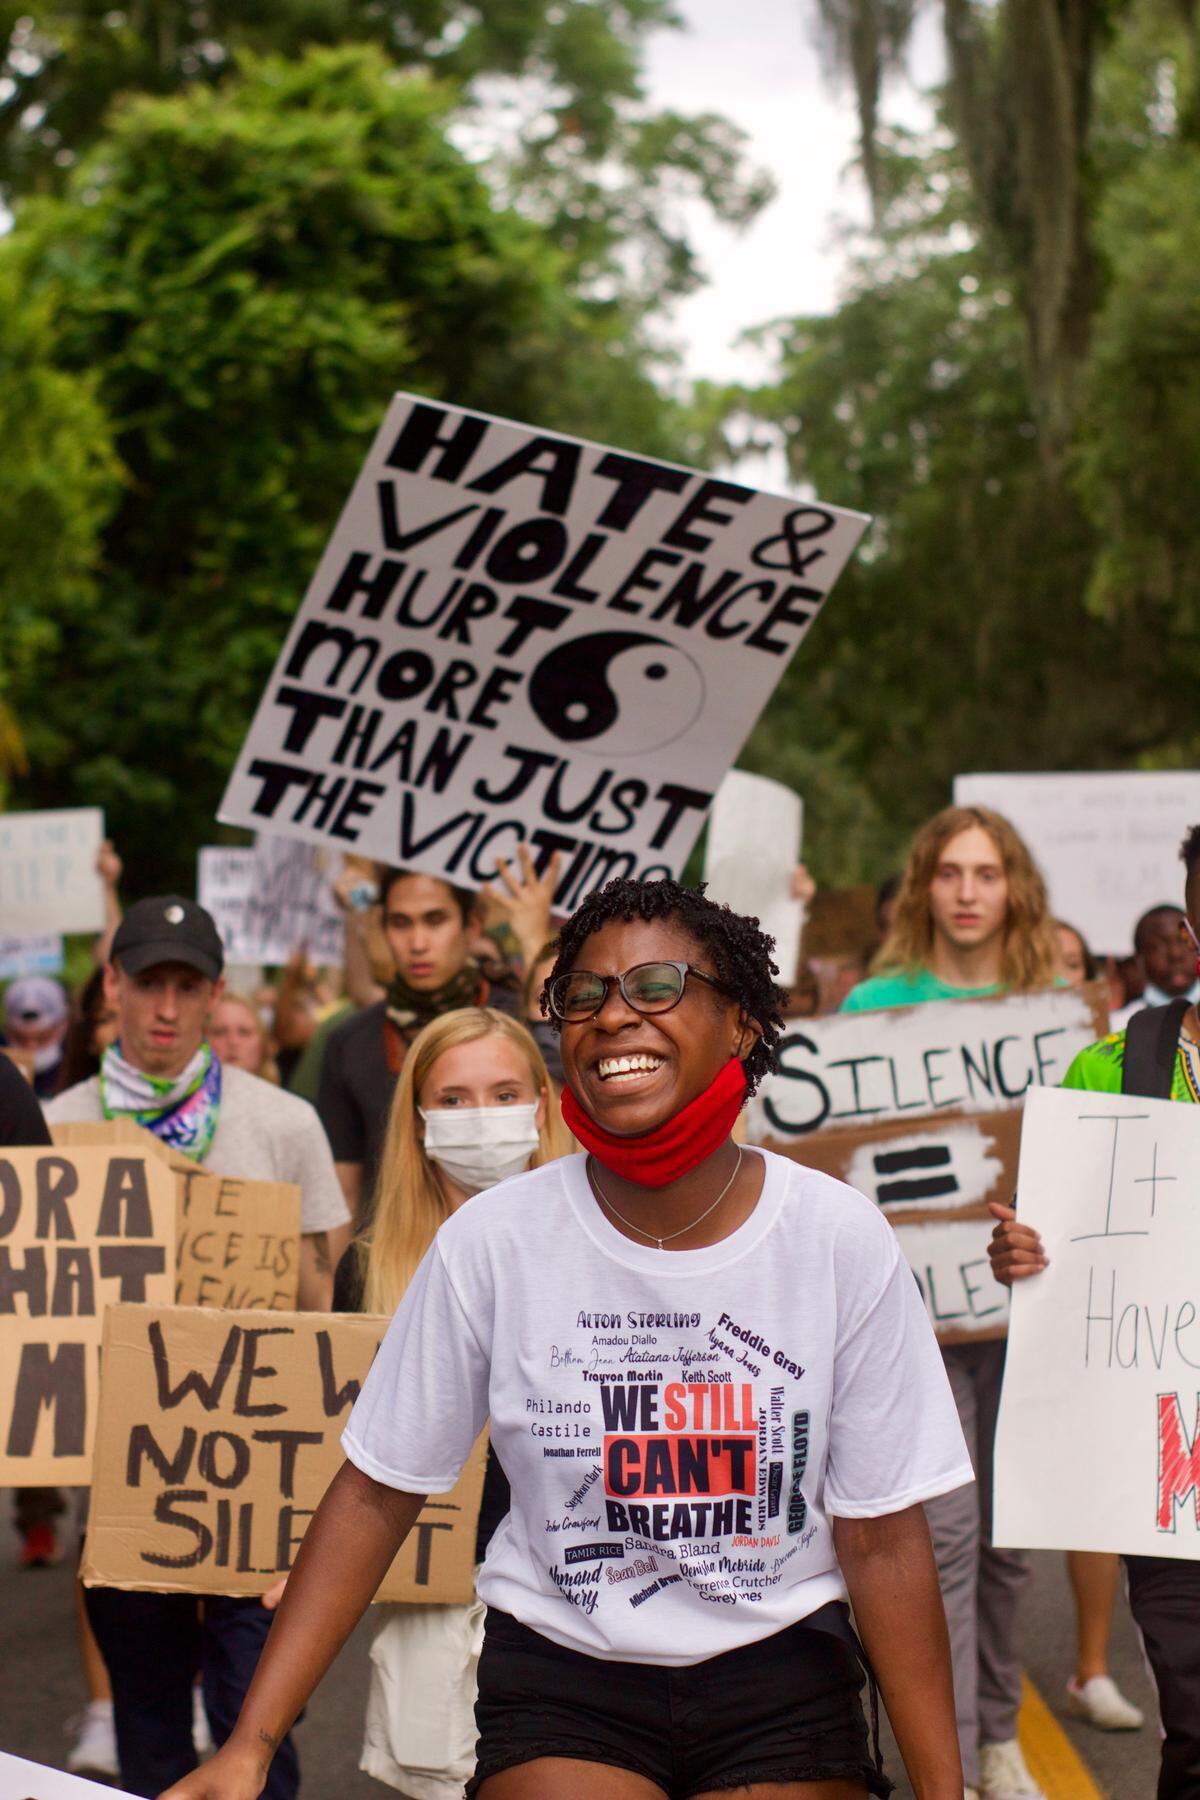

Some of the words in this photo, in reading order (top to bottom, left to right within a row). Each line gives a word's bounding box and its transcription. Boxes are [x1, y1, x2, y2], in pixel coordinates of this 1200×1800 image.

[385, 402, 757, 551] HATE
[750, 507, 836, 577] &
[376, 481, 824, 655] VIOLENCE
[324, 550, 574, 657] HURT
[274, 687, 475, 793] THAN
[473, 745, 713, 850] JUST
[248, 759, 386, 841] THE
[400, 790, 673, 912] VICTIM
[763, 1027, 1067, 1135] SILENCE
[592, 1335, 629, 1346] Amadou
[631, 1334, 658, 1345] Diallo
[1086, 1266, 1200, 1371] Have
[148, 1320, 294, 1417] WE
[619, 1346, 671, 1364] Atatiana
[672, 1346, 721, 1366] Jefferson
[718, 1312, 771, 1357] Freddie
[773, 1350, 806, 1380] Gray
[582, 1370, 623, 1385] Trayvon
[627, 1369, 663, 1382] Martin
[681, 1370, 706, 1383] Keith
[708, 1369, 732, 1383] Scott
[526, 1399, 591, 1413] Philando
[600, 1384, 659, 1432] WE
[664, 1383, 759, 1431] STILL
[770, 1386, 785, 1425] Walter
[531, 1423, 591, 1437] Castile
[543, 1447, 574, 1458] Jonathan
[576, 1447, 601, 1458] Ferrell
[758, 1407, 768, 1465] JORDAN
[771, 1425, 785, 1455] Scott
[793, 1412, 809, 1469] FLOYD
[126, 1423, 322, 1498] NOT
[608, 1438, 753, 1496] CAN'T
[564, 1480, 590, 1512] Stephon
[583, 1464, 604, 1485] Clark
[758, 1468, 767, 1531] EDWARDS
[140, 1489, 454, 1585] SILET
[605, 1498, 753, 1541] BREATHE
[731, 1535, 759, 1548] JORDAN
[761, 1534, 781, 1548] DAVIS
[566, 1549, 597, 1561] TAMIR
[599, 1546, 623, 1556] RICE
[605, 1566, 636, 1585] Sean
[635, 1555, 659, 1576] Bell
[624, 1537, 677, 1560] Sandra
[679, 1541, 721, 1559] Bland
[629, 1581, 661, 1608] Michael
[699, 1591, 737, 1605] Corey
[732, 1573, 784, 1588] Crutcher
